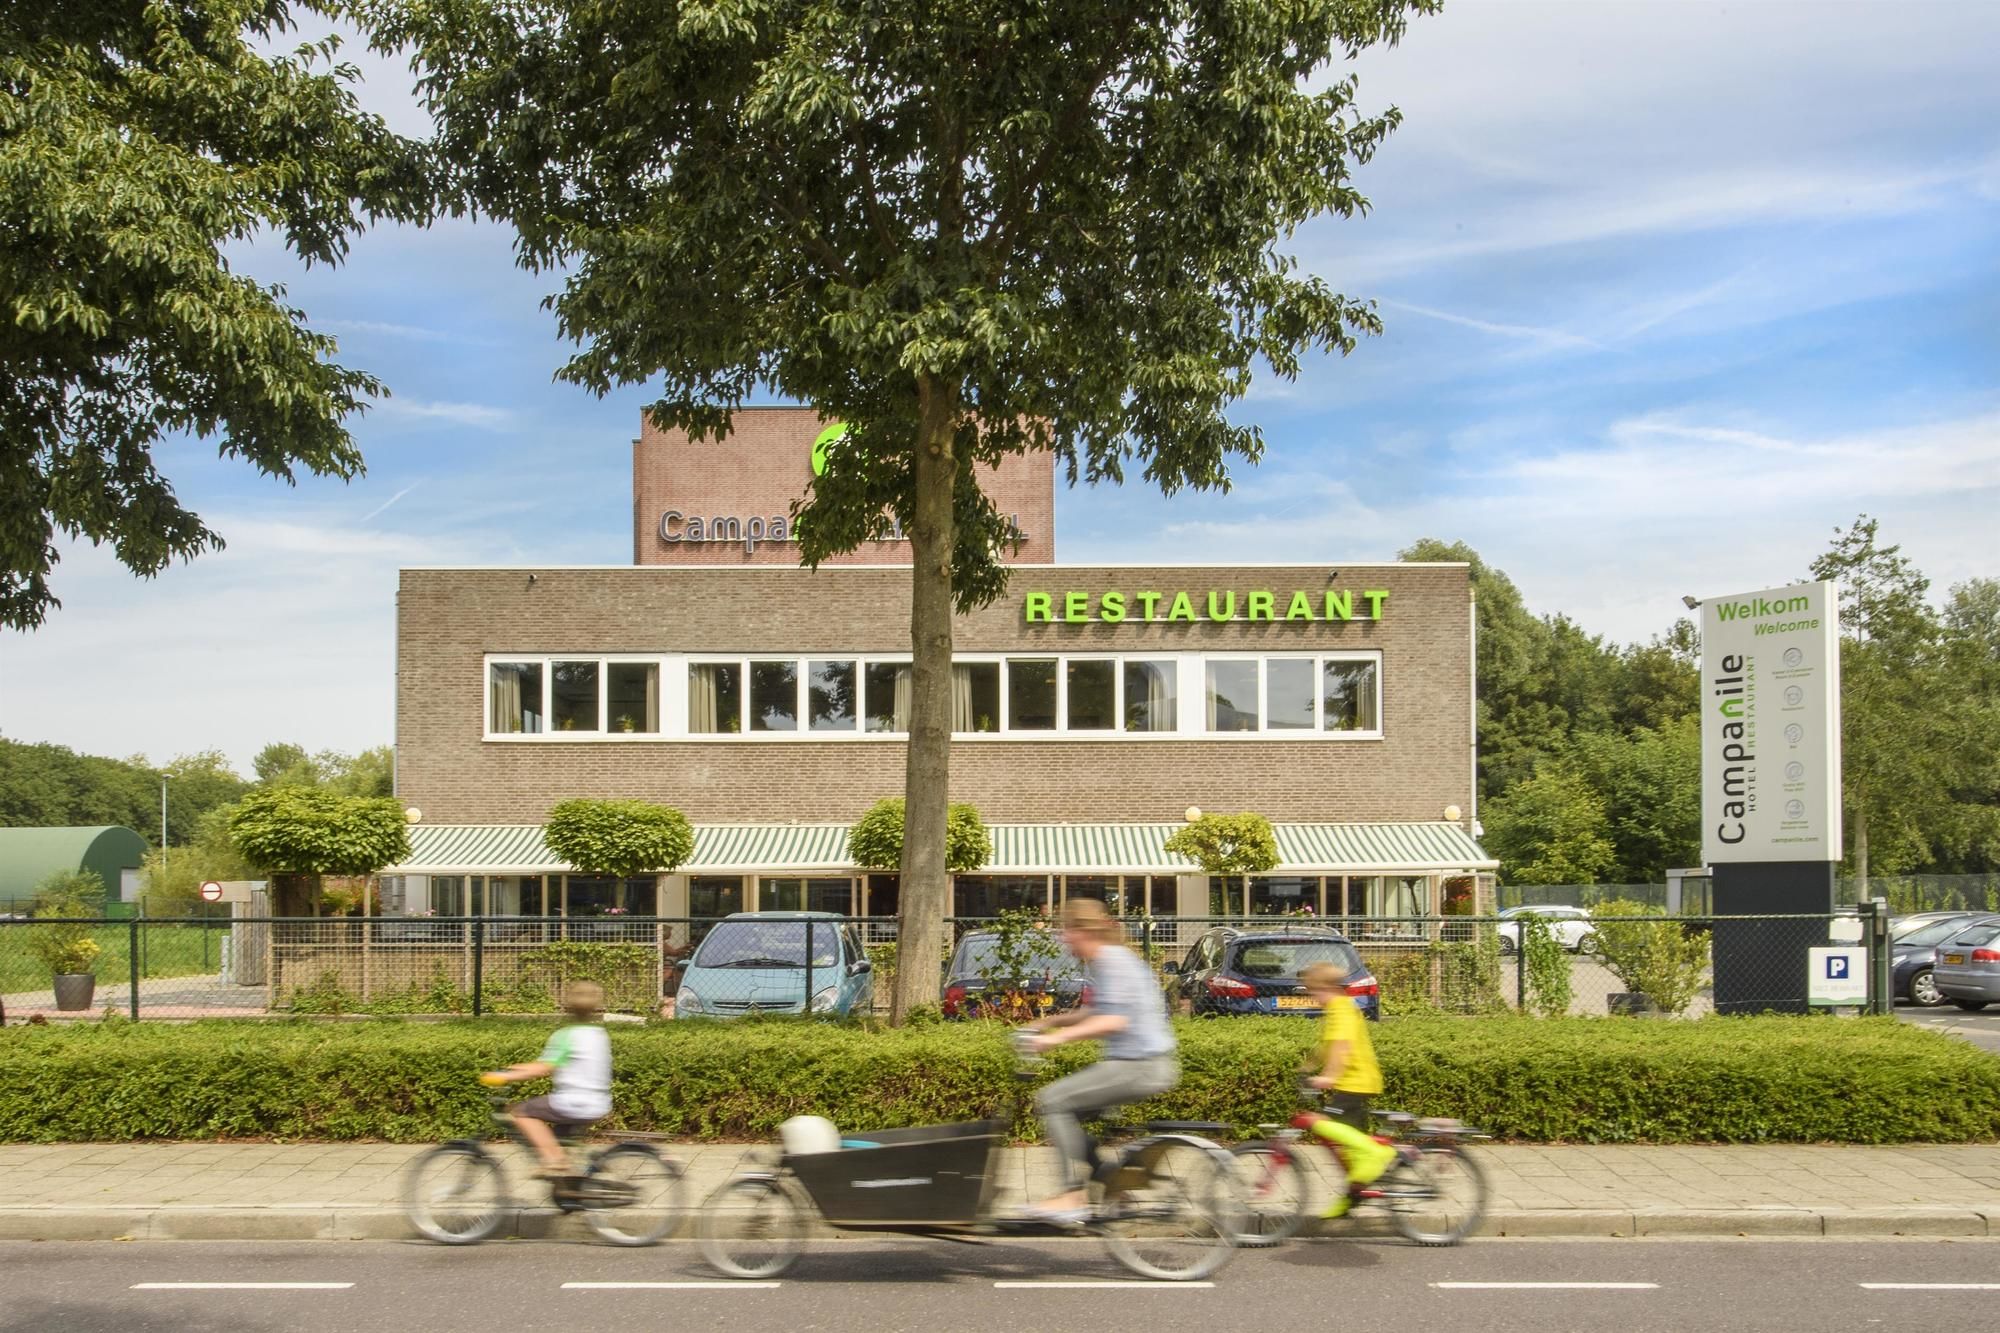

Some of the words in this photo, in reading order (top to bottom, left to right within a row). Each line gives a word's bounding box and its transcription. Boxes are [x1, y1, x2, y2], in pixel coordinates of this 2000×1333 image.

[659, 510, 803, 553] Campa
[1025, 590, 1390, 622] RESTAURANT
[1717, 596, 1809, 622] Welkom
[1754, 618, 1820, 636] Welcome
[1746, 656, 1756, 748] RESTAURANT
[1715, 655, 1755, 844] Campanile
[1747, 767, 1756, 812] HOTEL
[1831, 959, 1846, 977] P
